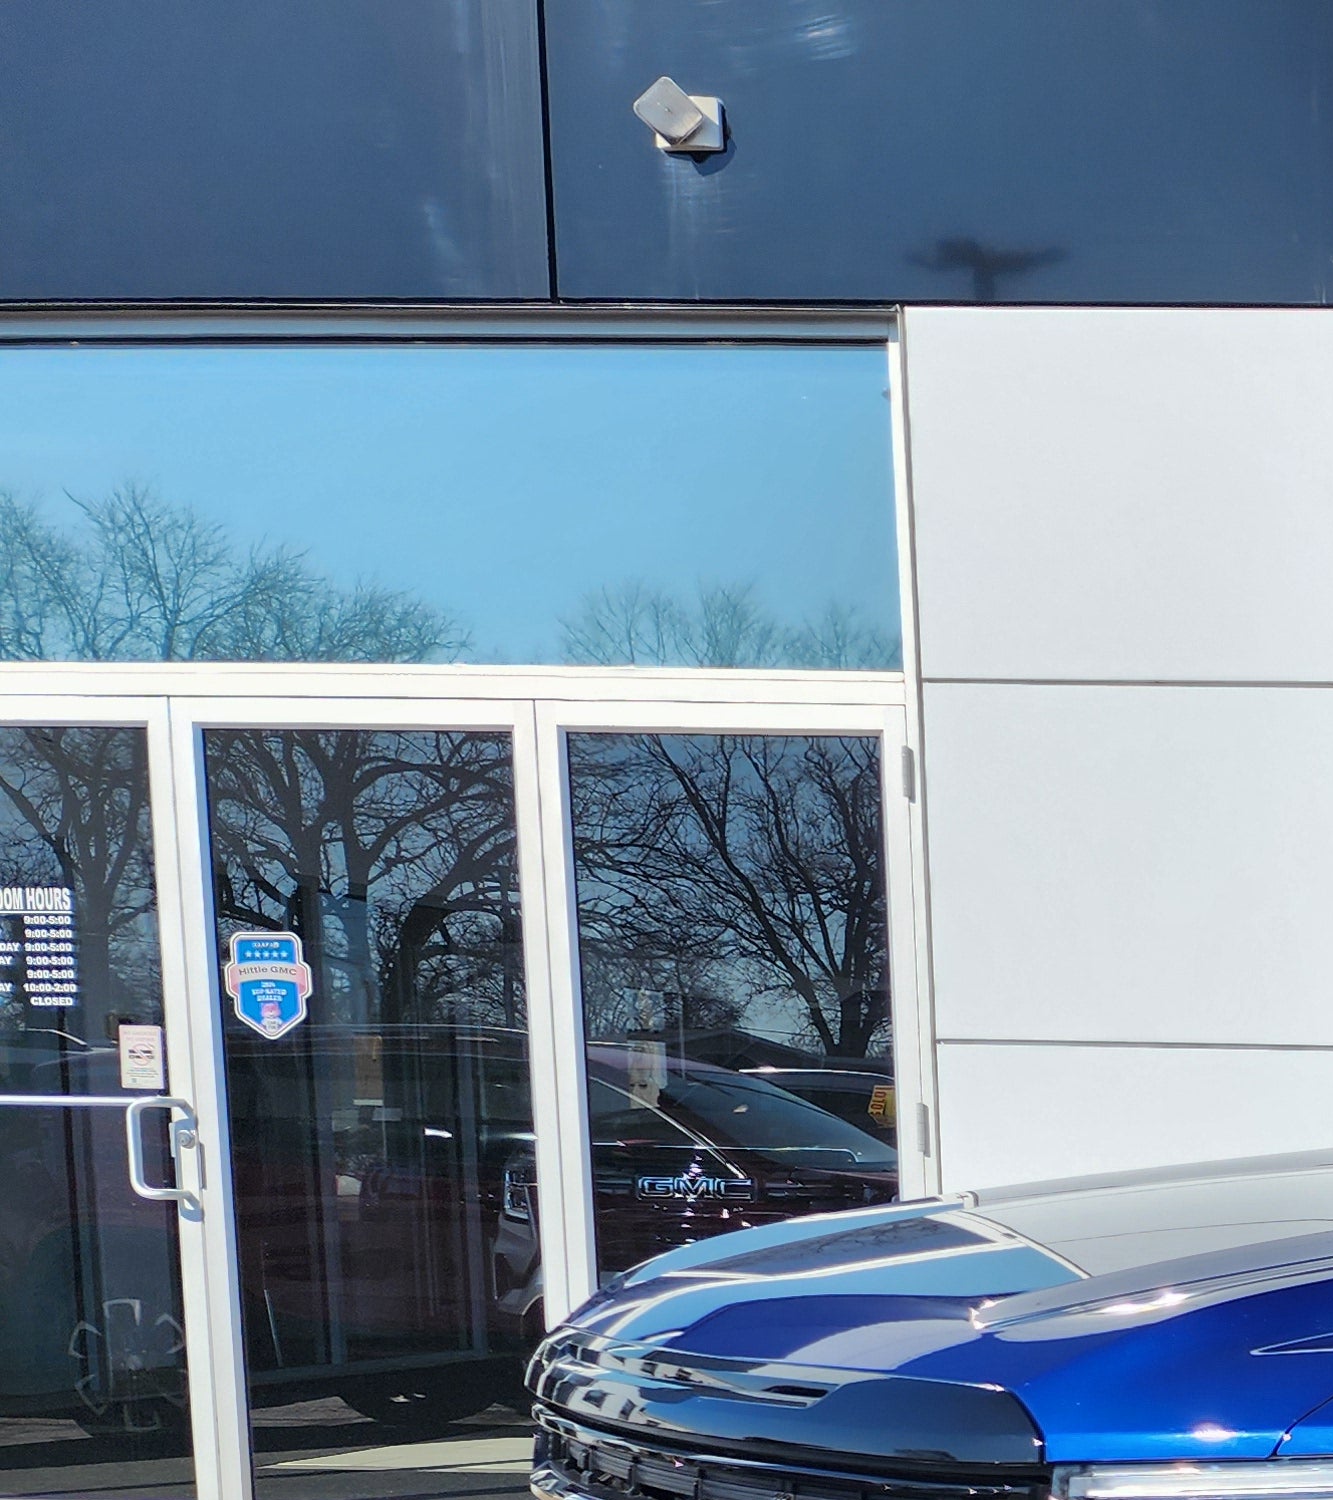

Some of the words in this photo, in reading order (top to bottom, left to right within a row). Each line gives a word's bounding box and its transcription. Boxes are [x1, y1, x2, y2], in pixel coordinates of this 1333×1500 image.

[25, 887, 71, 910] HOURS
[23, 915, 71, 925] 9:00-5:00
[24, 929, 72, 939] 9:00-5:00
[24, 942, 72, 952] 9:00-5:00
[26, 956, 74, 966] 9:00-5:00
[26, 969, 74, 979] 9:00-5:00
[239, 966, 268, 975] Hittle
[270, 966, 297, 976] GMC
[23, 983, 77, 993] 10:00-2:00
[30, 996, 73, 1006] CLOSED
[637, 1176, 752, 1200] GMC
